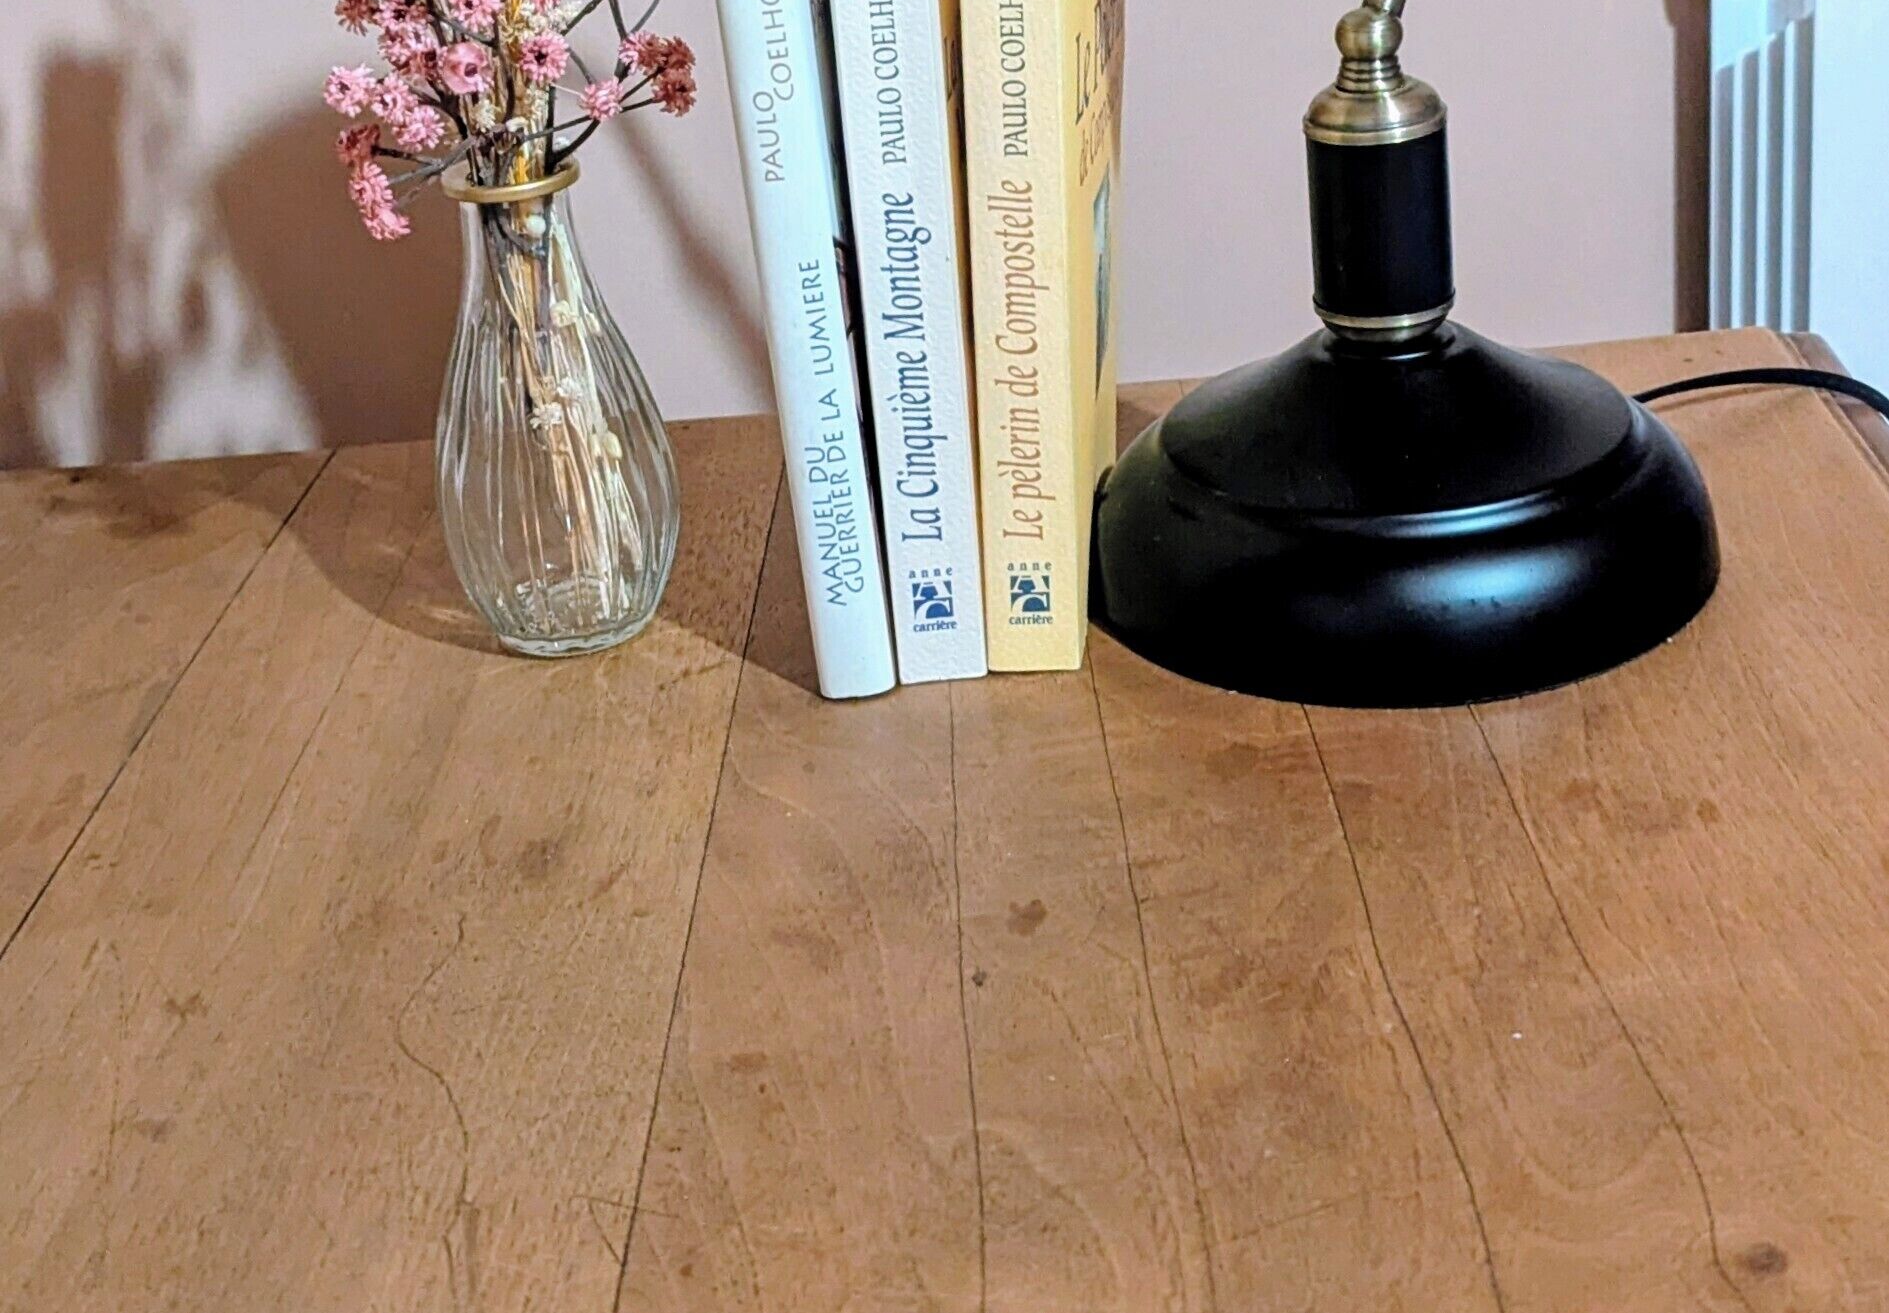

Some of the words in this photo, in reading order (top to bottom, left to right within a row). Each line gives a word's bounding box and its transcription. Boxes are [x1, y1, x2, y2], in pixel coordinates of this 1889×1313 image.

[753, 90, 785, 183] PAULO
[876, 86, 907, 166] PAULO
[1003, 79, 1028, 158] PAULO
[880, 190, 932, 343] Montagne
[986, 178, 1050, 357] Compostelle
[798, 258, 834, 377] LUMIERE
[820, 387, 842, 425] LA
[994, 363, 1039, 399] de
[822, 429, 847, 471] DE
[888, 349, 949, 500] Cinquième
[804, 446, 827, 485] DU
[996, 407, 1056, 503] pèlerin
[811, 492, 848, 607] MANUEL
[830, 468, 864, 594] GUERRIER
[902, 507, 943, 542] La
[1003, 508, 1044, 541] Le
[908, 566, 953, 579] anne
[1006, 561, 1052, 572] anne
[913, 619, 958, 634] carrière
[1008, 613, 1055, 626] carrière
